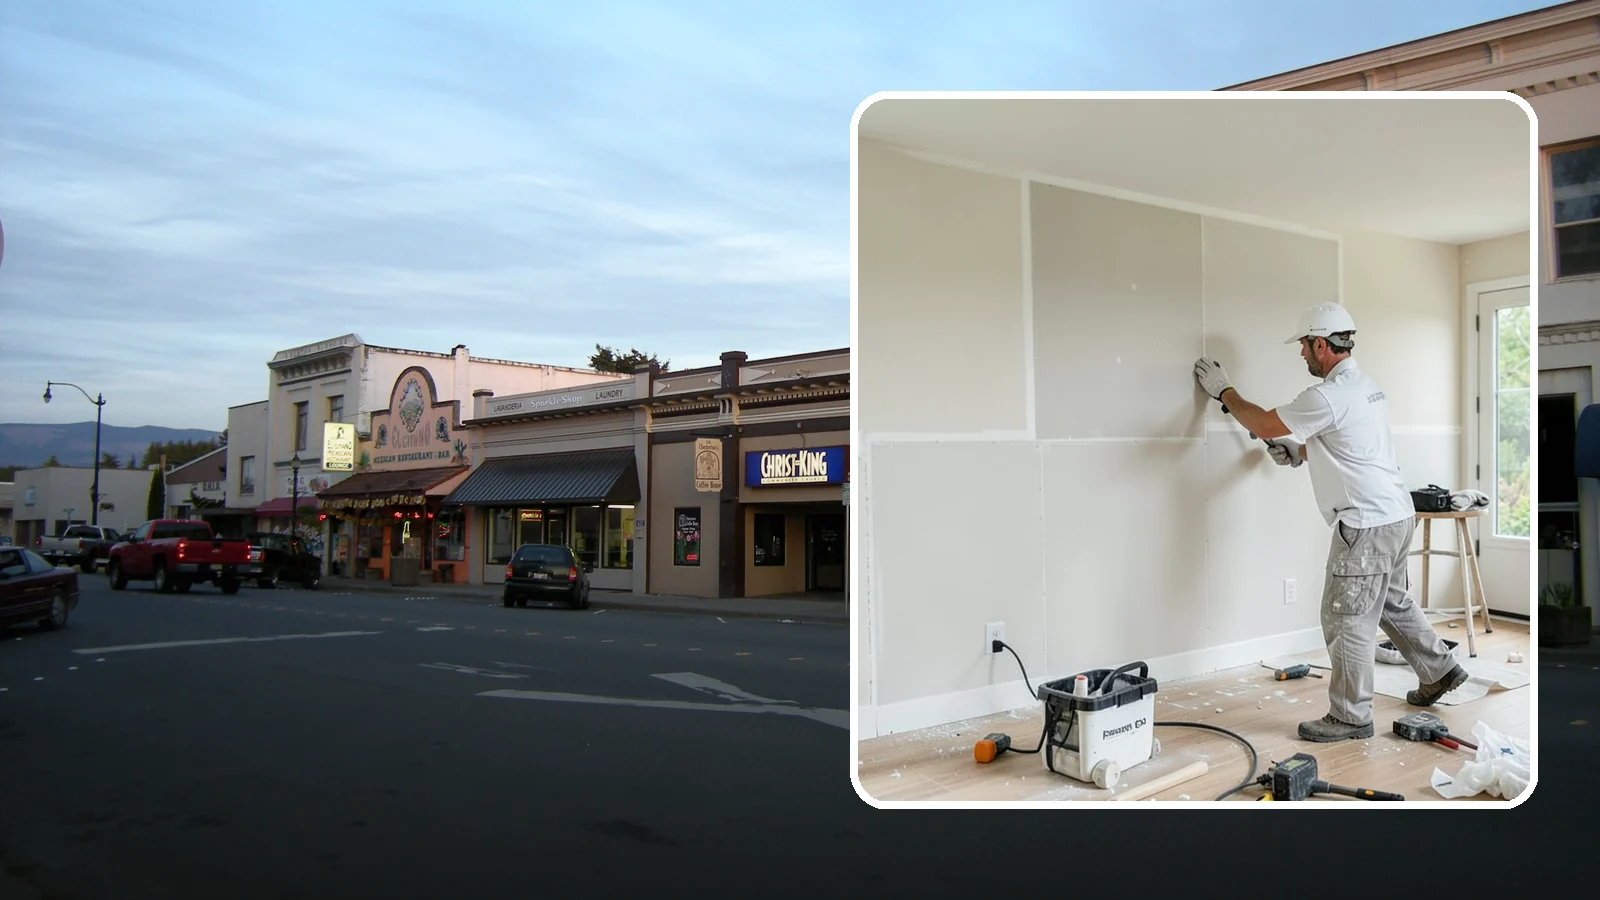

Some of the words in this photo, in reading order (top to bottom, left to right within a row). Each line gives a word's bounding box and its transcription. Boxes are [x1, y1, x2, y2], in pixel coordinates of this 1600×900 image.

[561, 394, 583, 406] Shop
[595, 388, 624, 400] LAUNDRY
[493, 402, 523, 413] LAVANDERIA
[374, 455, 397, 464] MEXICAN
[397, 452, 434, 462] RESTAURANT
[438, 450, 450, 459] BAR
